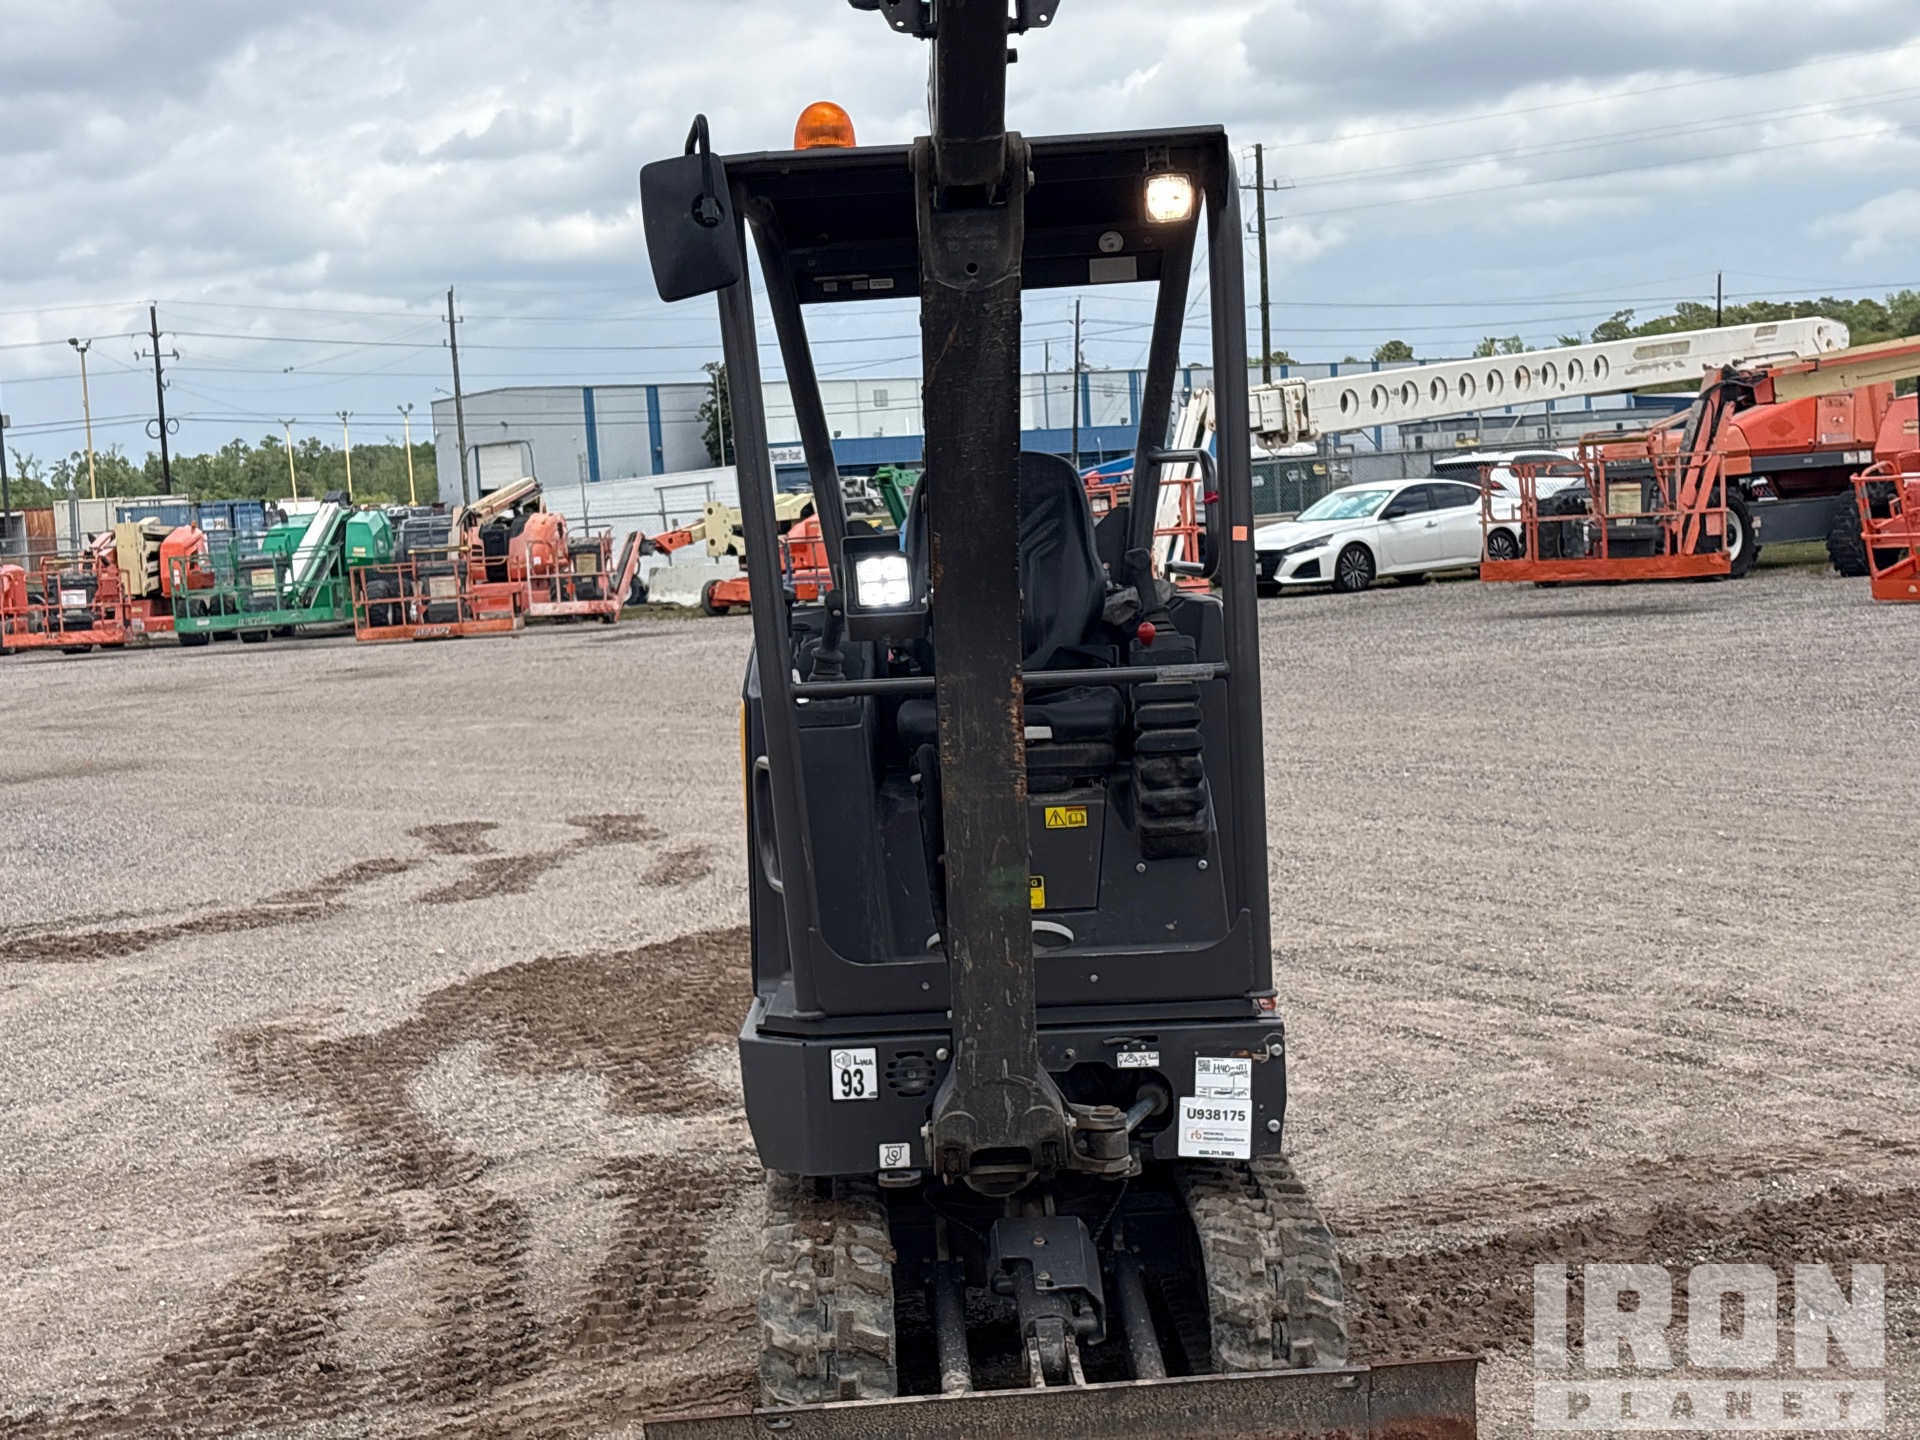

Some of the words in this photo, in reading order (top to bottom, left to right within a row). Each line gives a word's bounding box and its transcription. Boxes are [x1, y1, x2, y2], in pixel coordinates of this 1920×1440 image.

[841, 1068, 865, 1097] 93
[1187, 1107, 1246, 1121] U938175
[1191, 1129, 1202, 1140] rb
